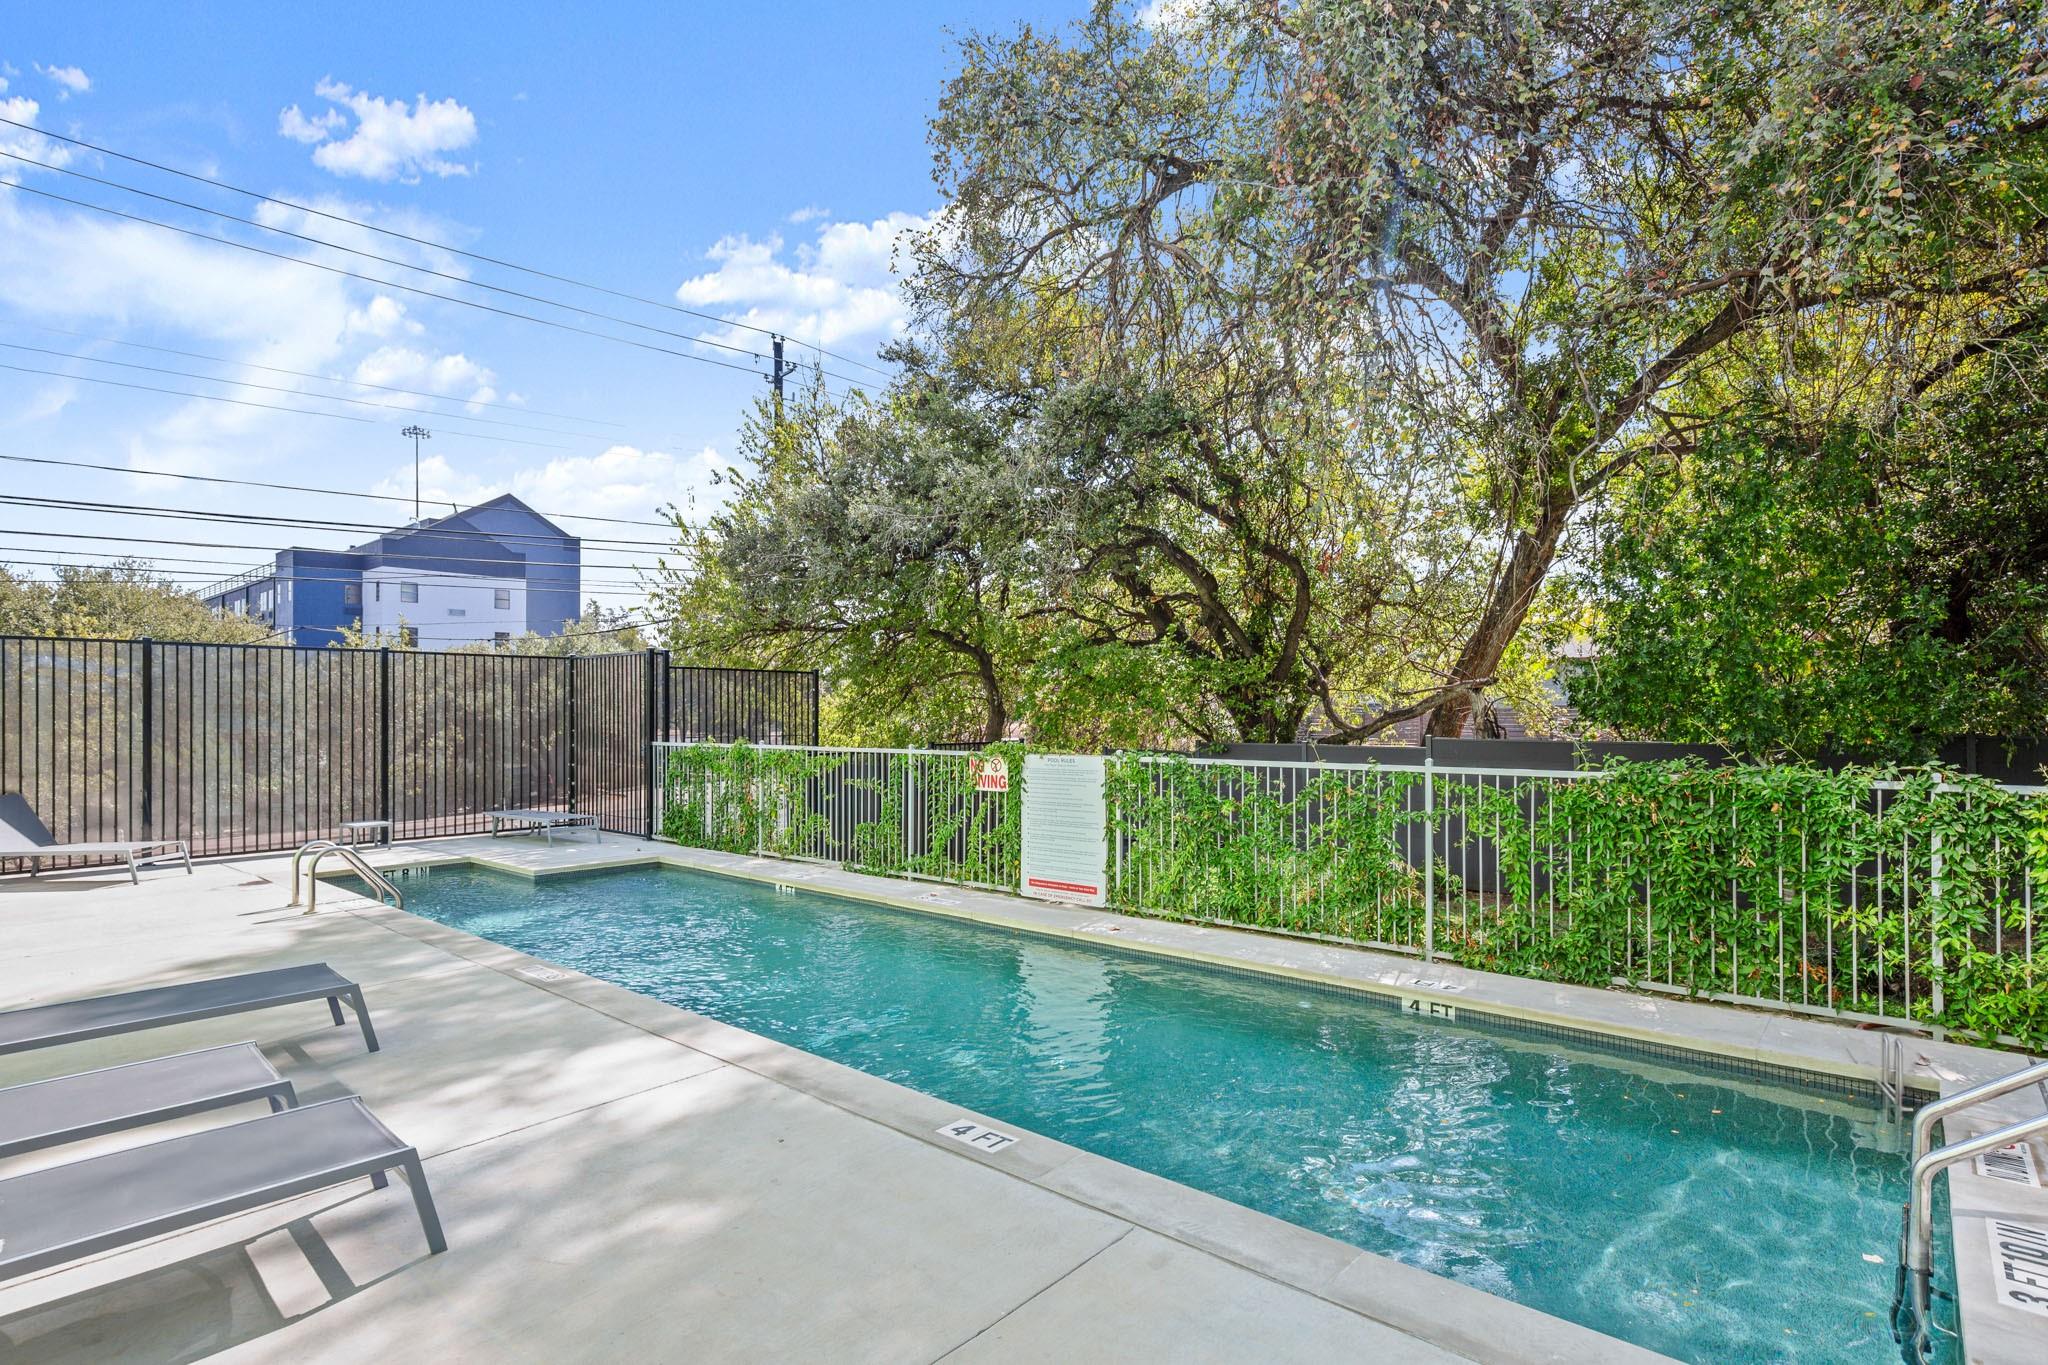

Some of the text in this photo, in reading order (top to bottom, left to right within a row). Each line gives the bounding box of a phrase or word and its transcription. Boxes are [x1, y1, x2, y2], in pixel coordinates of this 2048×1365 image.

[977, 774, 1007, 789] IVING
[1409, 1000, 1453, 1017] 4 FT
[951, 1125, 1014, 1149] 4 FT
[1996, 1221, 2048, 1248] IN
[2003, 1261, 2048, 1290] FT
[2009, 1290, 2048, 1309] 3
